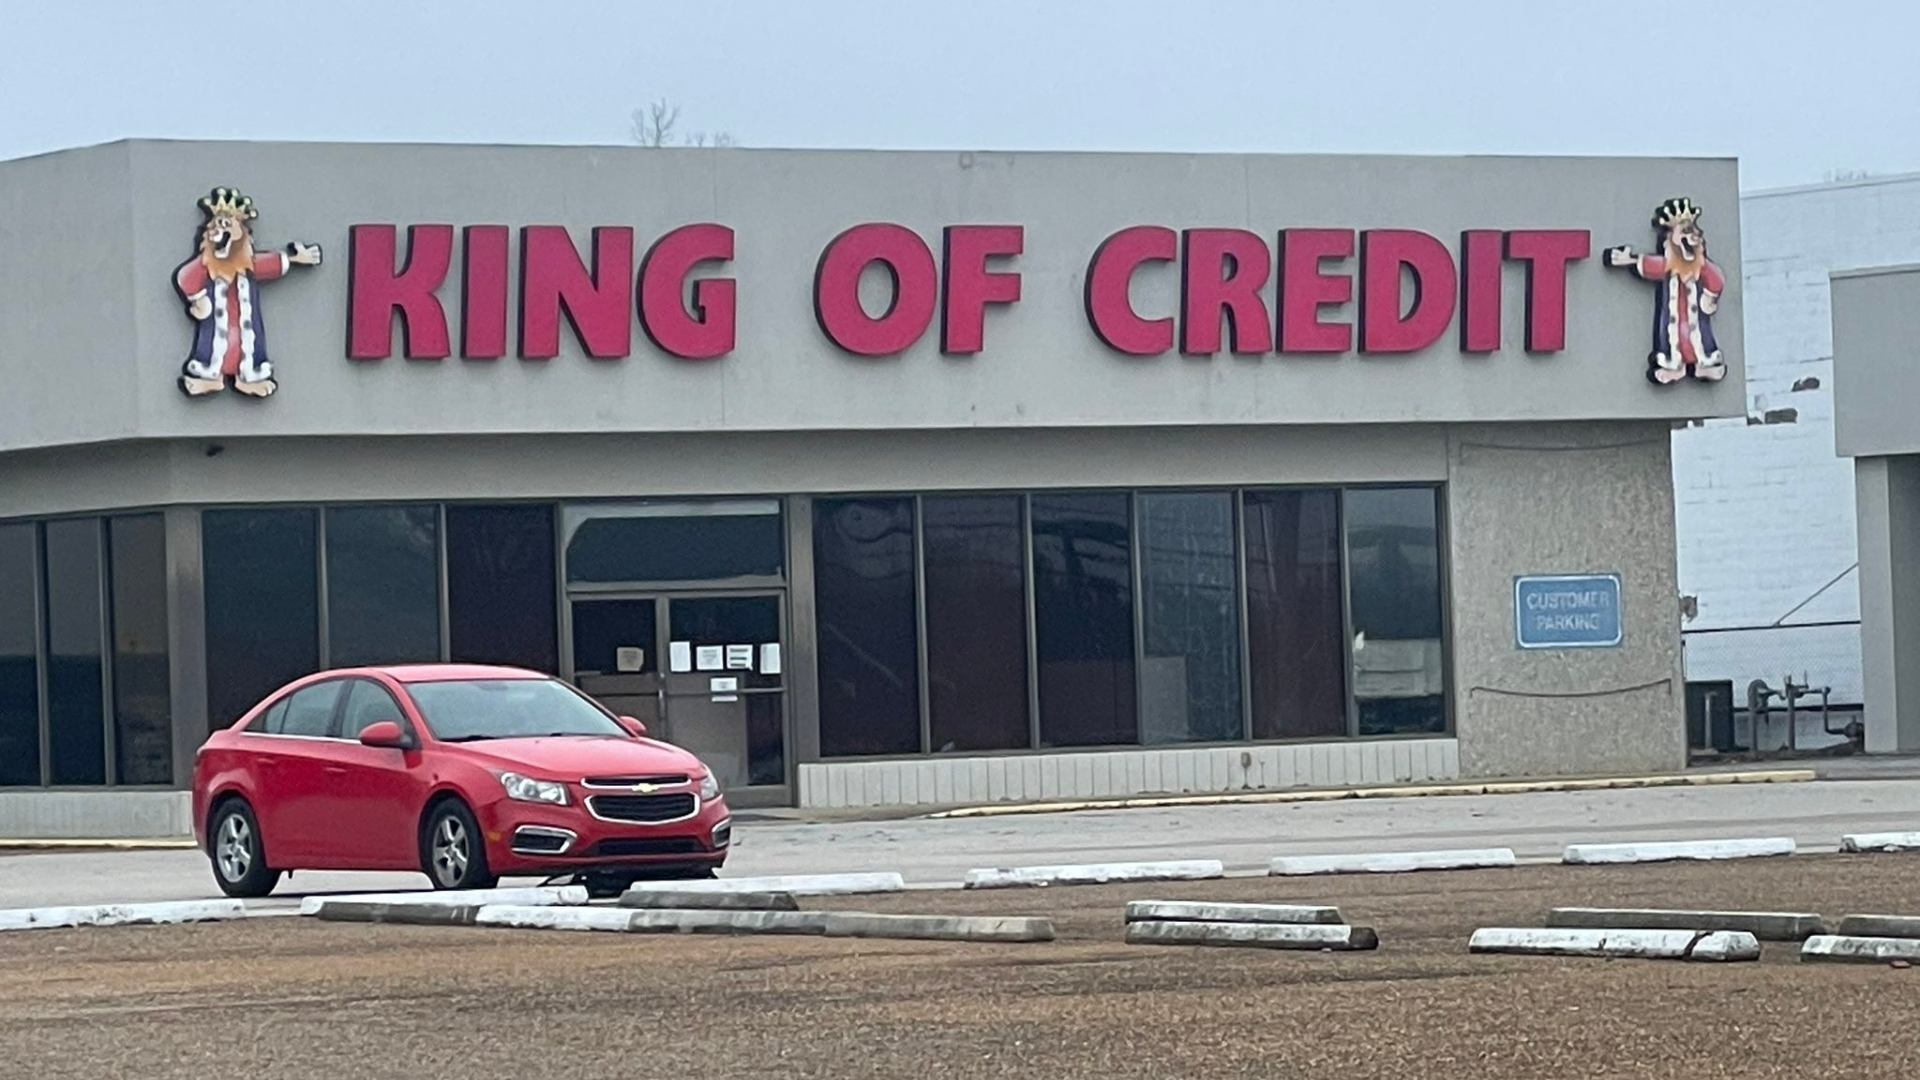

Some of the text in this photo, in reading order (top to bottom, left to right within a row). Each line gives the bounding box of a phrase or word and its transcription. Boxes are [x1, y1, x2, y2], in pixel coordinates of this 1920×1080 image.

[346, 222, 1591, 360] KING OF CREDIT
[1526, 591, 1610, 610] CUSTOMER
[1536, 613, 1600, 631] PARKING
